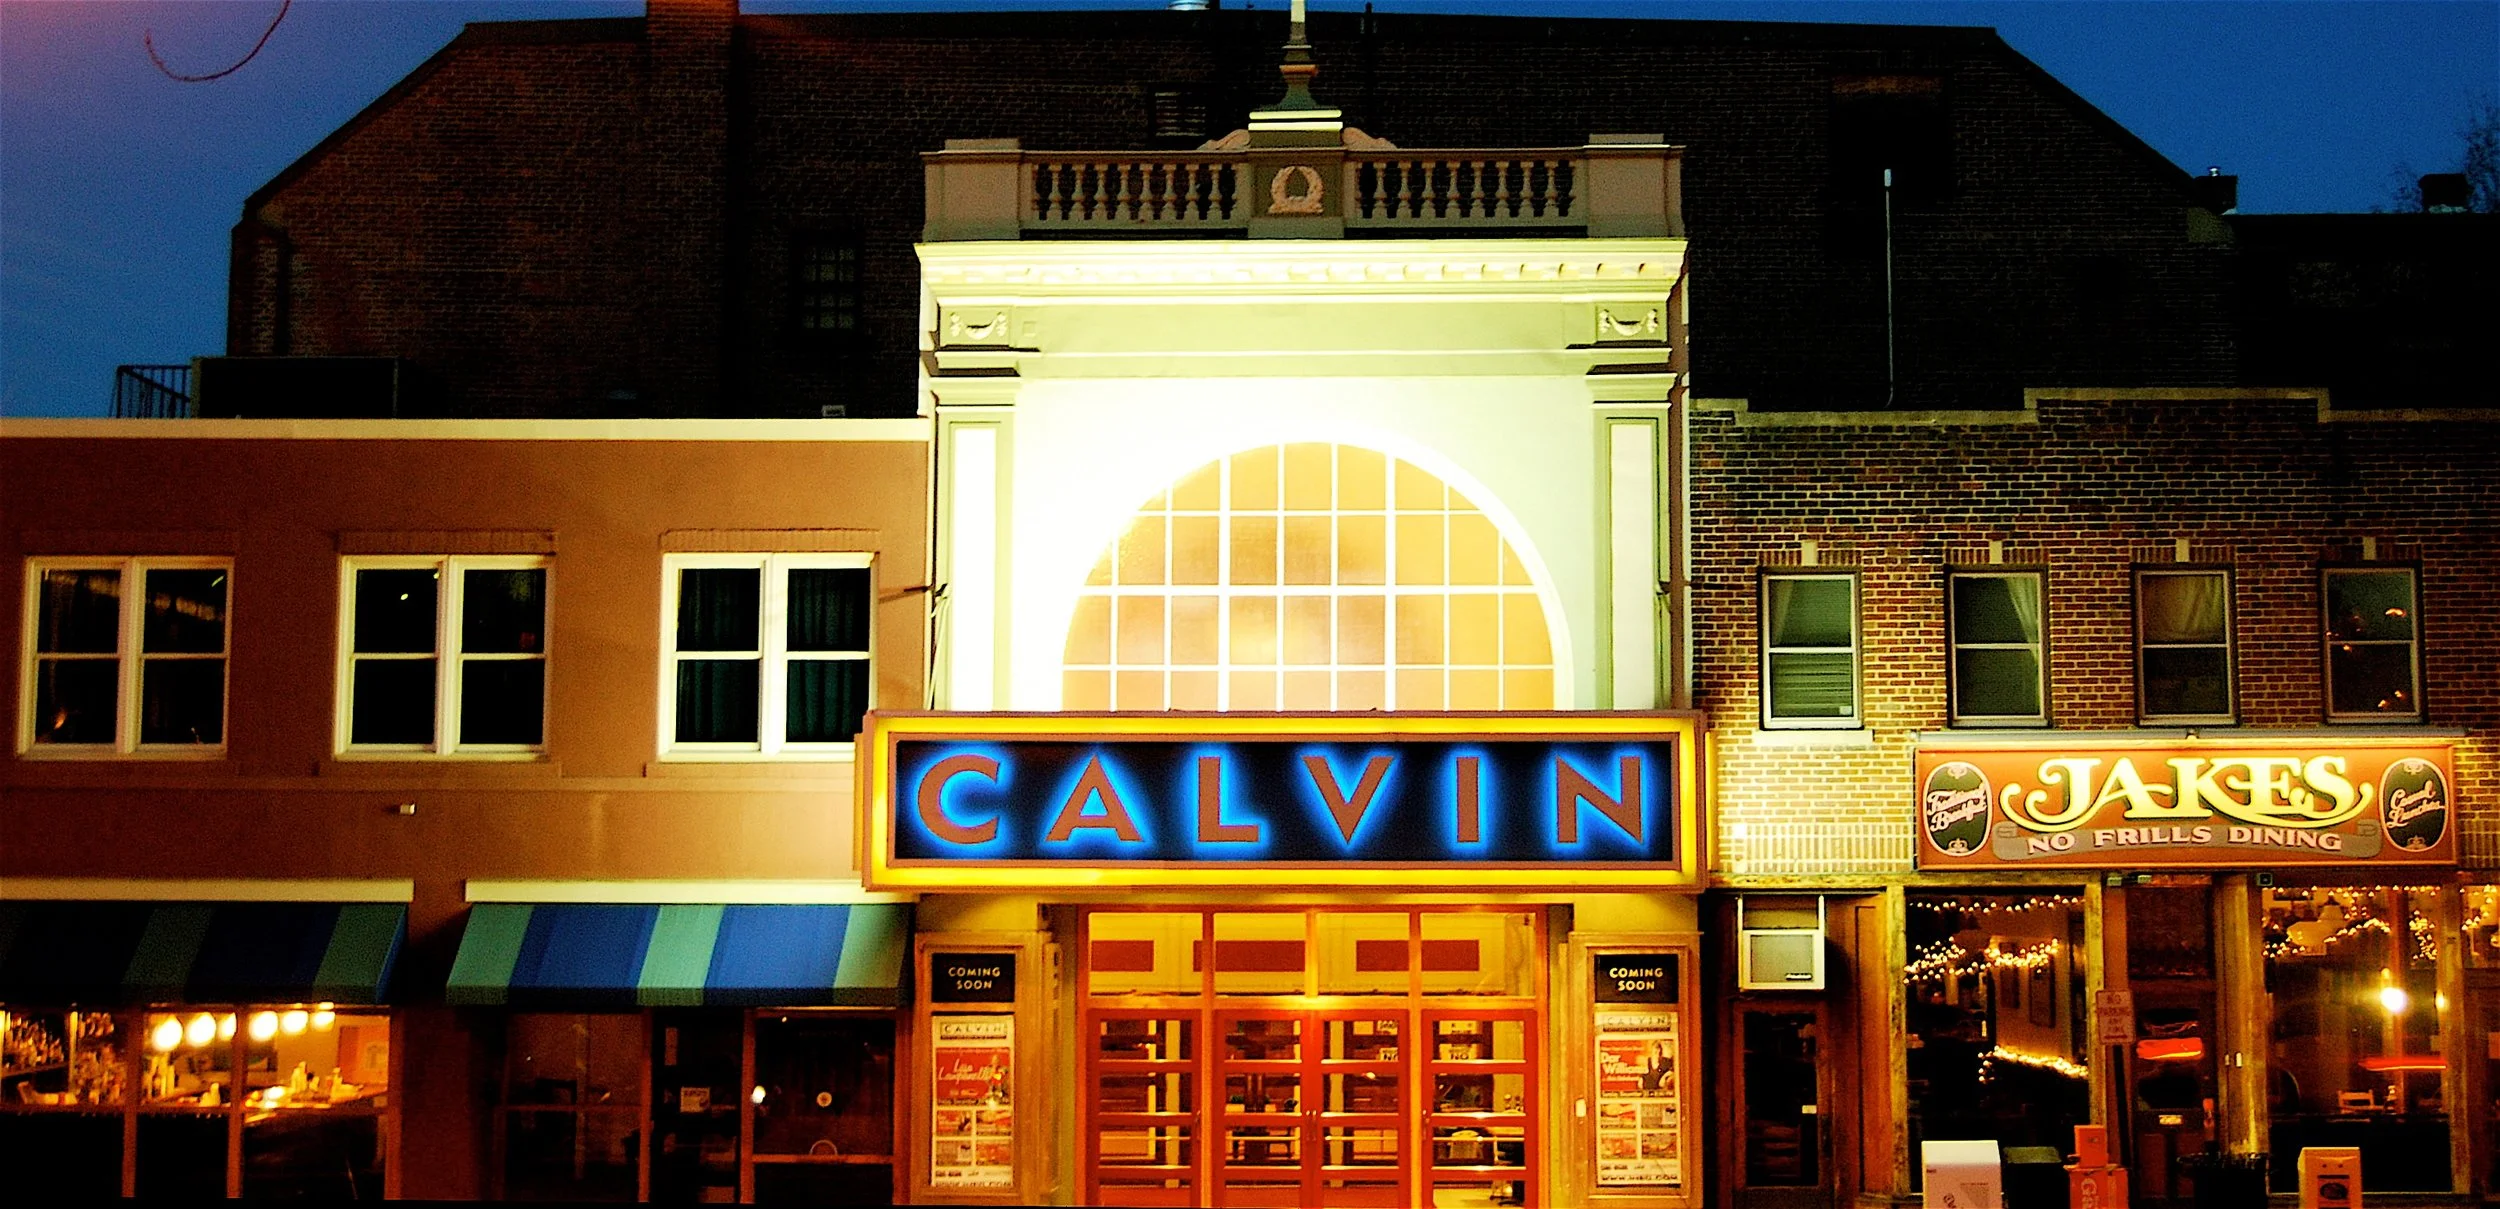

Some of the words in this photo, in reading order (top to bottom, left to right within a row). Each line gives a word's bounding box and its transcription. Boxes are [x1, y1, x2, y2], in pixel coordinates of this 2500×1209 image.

[917, 754, 1644, 844] CALVIN
[2000, 756, 2374, 832] JAKES
[2027, 831, 2077, 855] NO
[2093, 825, 2212, 847] FRILLS
[2228, 828, 2342, 852] DINING
[948, 967, 1001, 978] COMING
[1609, 967, 1664, 978] COMING
[956, 979, 993, 990] SOON
[1617, 980, 1655, 991] SOON
[1607, 1016, 1666, 1026] CALVIN
